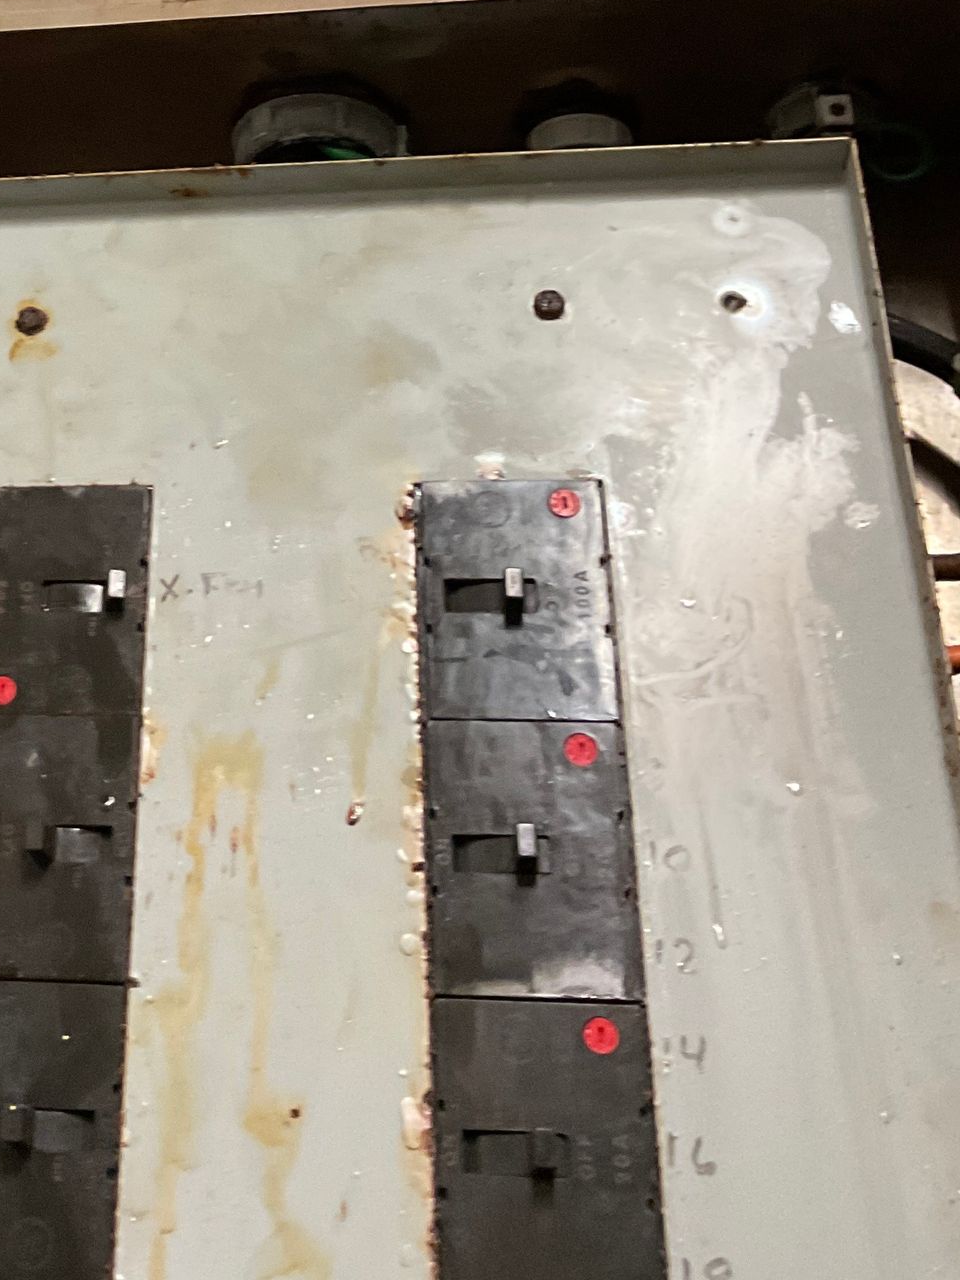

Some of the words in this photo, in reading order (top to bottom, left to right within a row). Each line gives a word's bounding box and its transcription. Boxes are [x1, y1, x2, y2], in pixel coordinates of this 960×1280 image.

[573, 570, 592, 620] 100A
[649, 840, 691, 871] 10
[655, 937, 697, 974] 12
[662, 1035, 707, 1072] 14
[667, 1131, 718, 1177] 16
